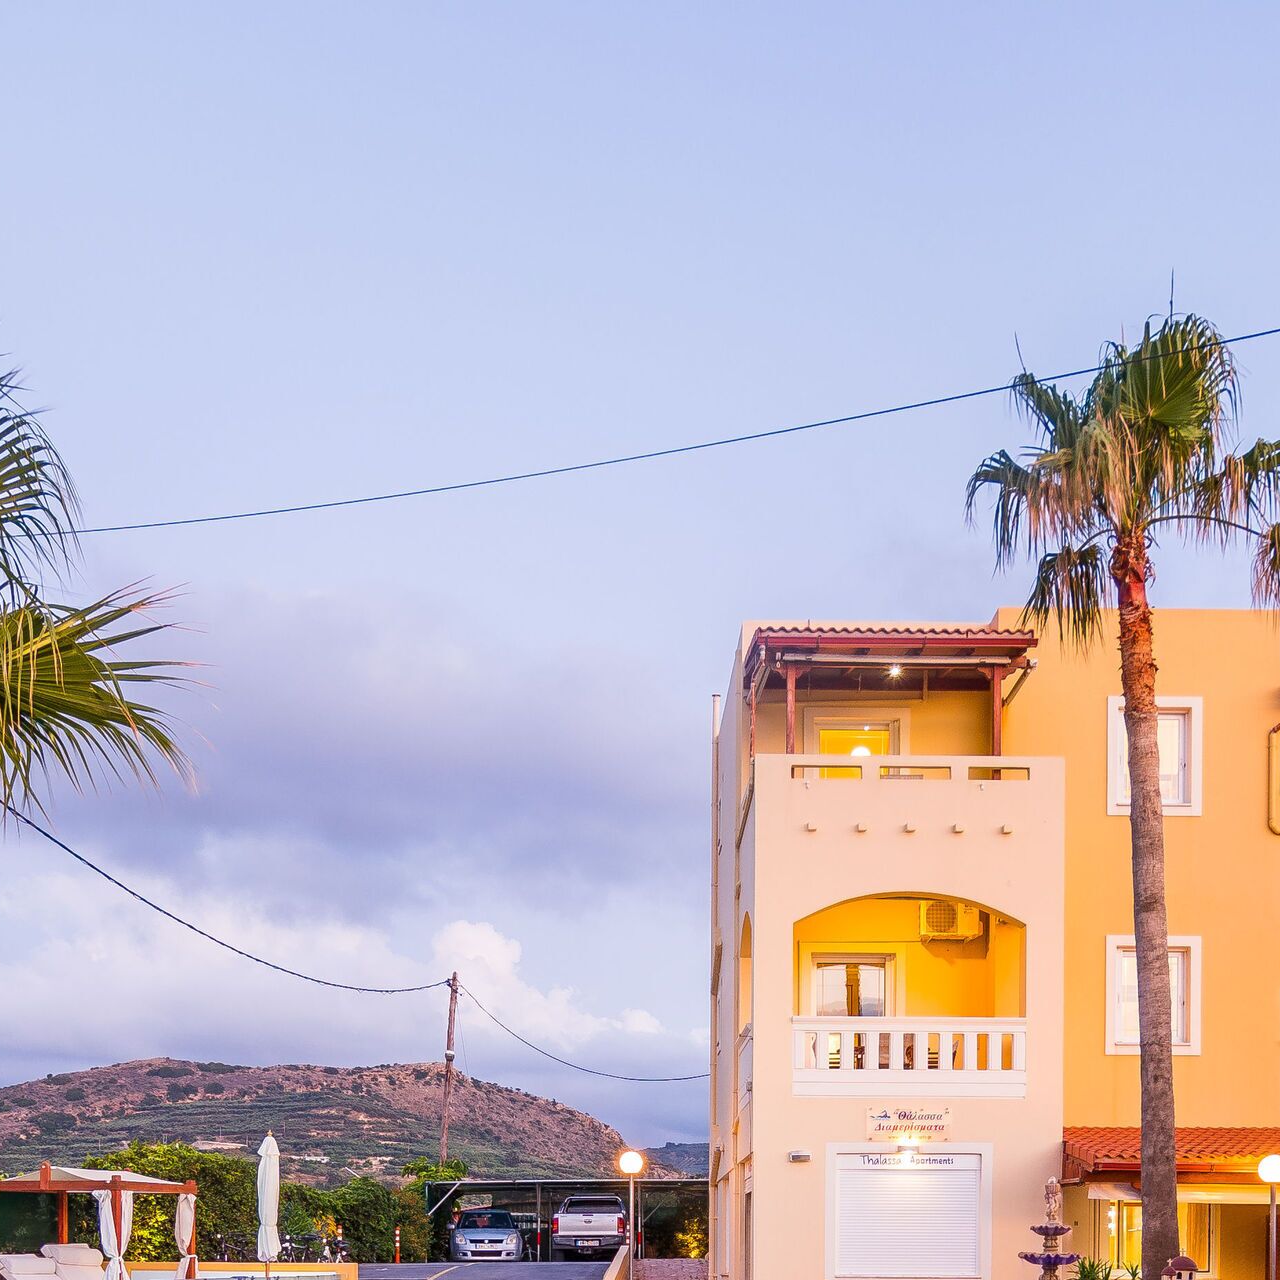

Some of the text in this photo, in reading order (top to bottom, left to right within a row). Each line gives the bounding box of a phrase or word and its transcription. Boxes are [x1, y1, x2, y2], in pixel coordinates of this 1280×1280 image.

[874, 1122, 945, 1133] Διαμερίσματα
[860, 1154, 954, 1165] Thalassa Apartments
